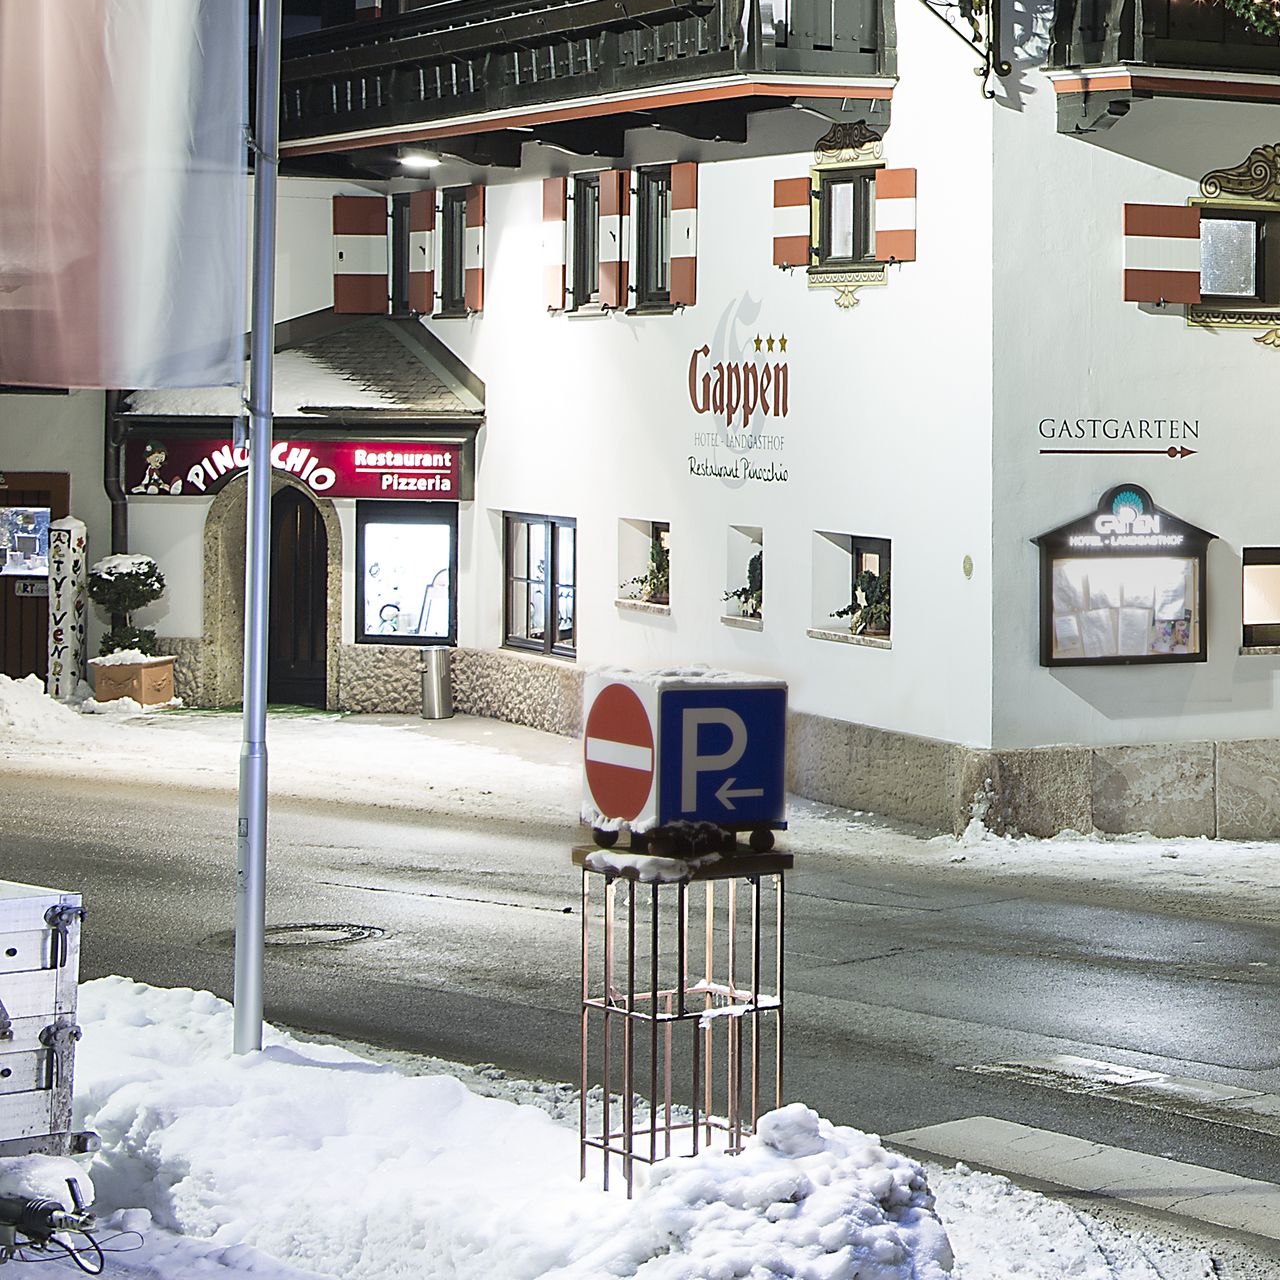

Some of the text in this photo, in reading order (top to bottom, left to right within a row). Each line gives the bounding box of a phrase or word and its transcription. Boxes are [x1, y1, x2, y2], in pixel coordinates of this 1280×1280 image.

[689, 344, 789, 428] Gappen
[1038, 418, 1199, 439] GASTGARTEN
[694, 432, 719, 447] HOTEL
[726, 433, 785, 451] LANDGASTHOF
[186, 439, 337, 491] PINOCHIO
[354, 449, 452, 467] Restaurant
[687, 455, 789, 482] Restaurant Pinocchio
[382, 474, 452, 491] Pizzeria
[681, 707, 748, 813] P
